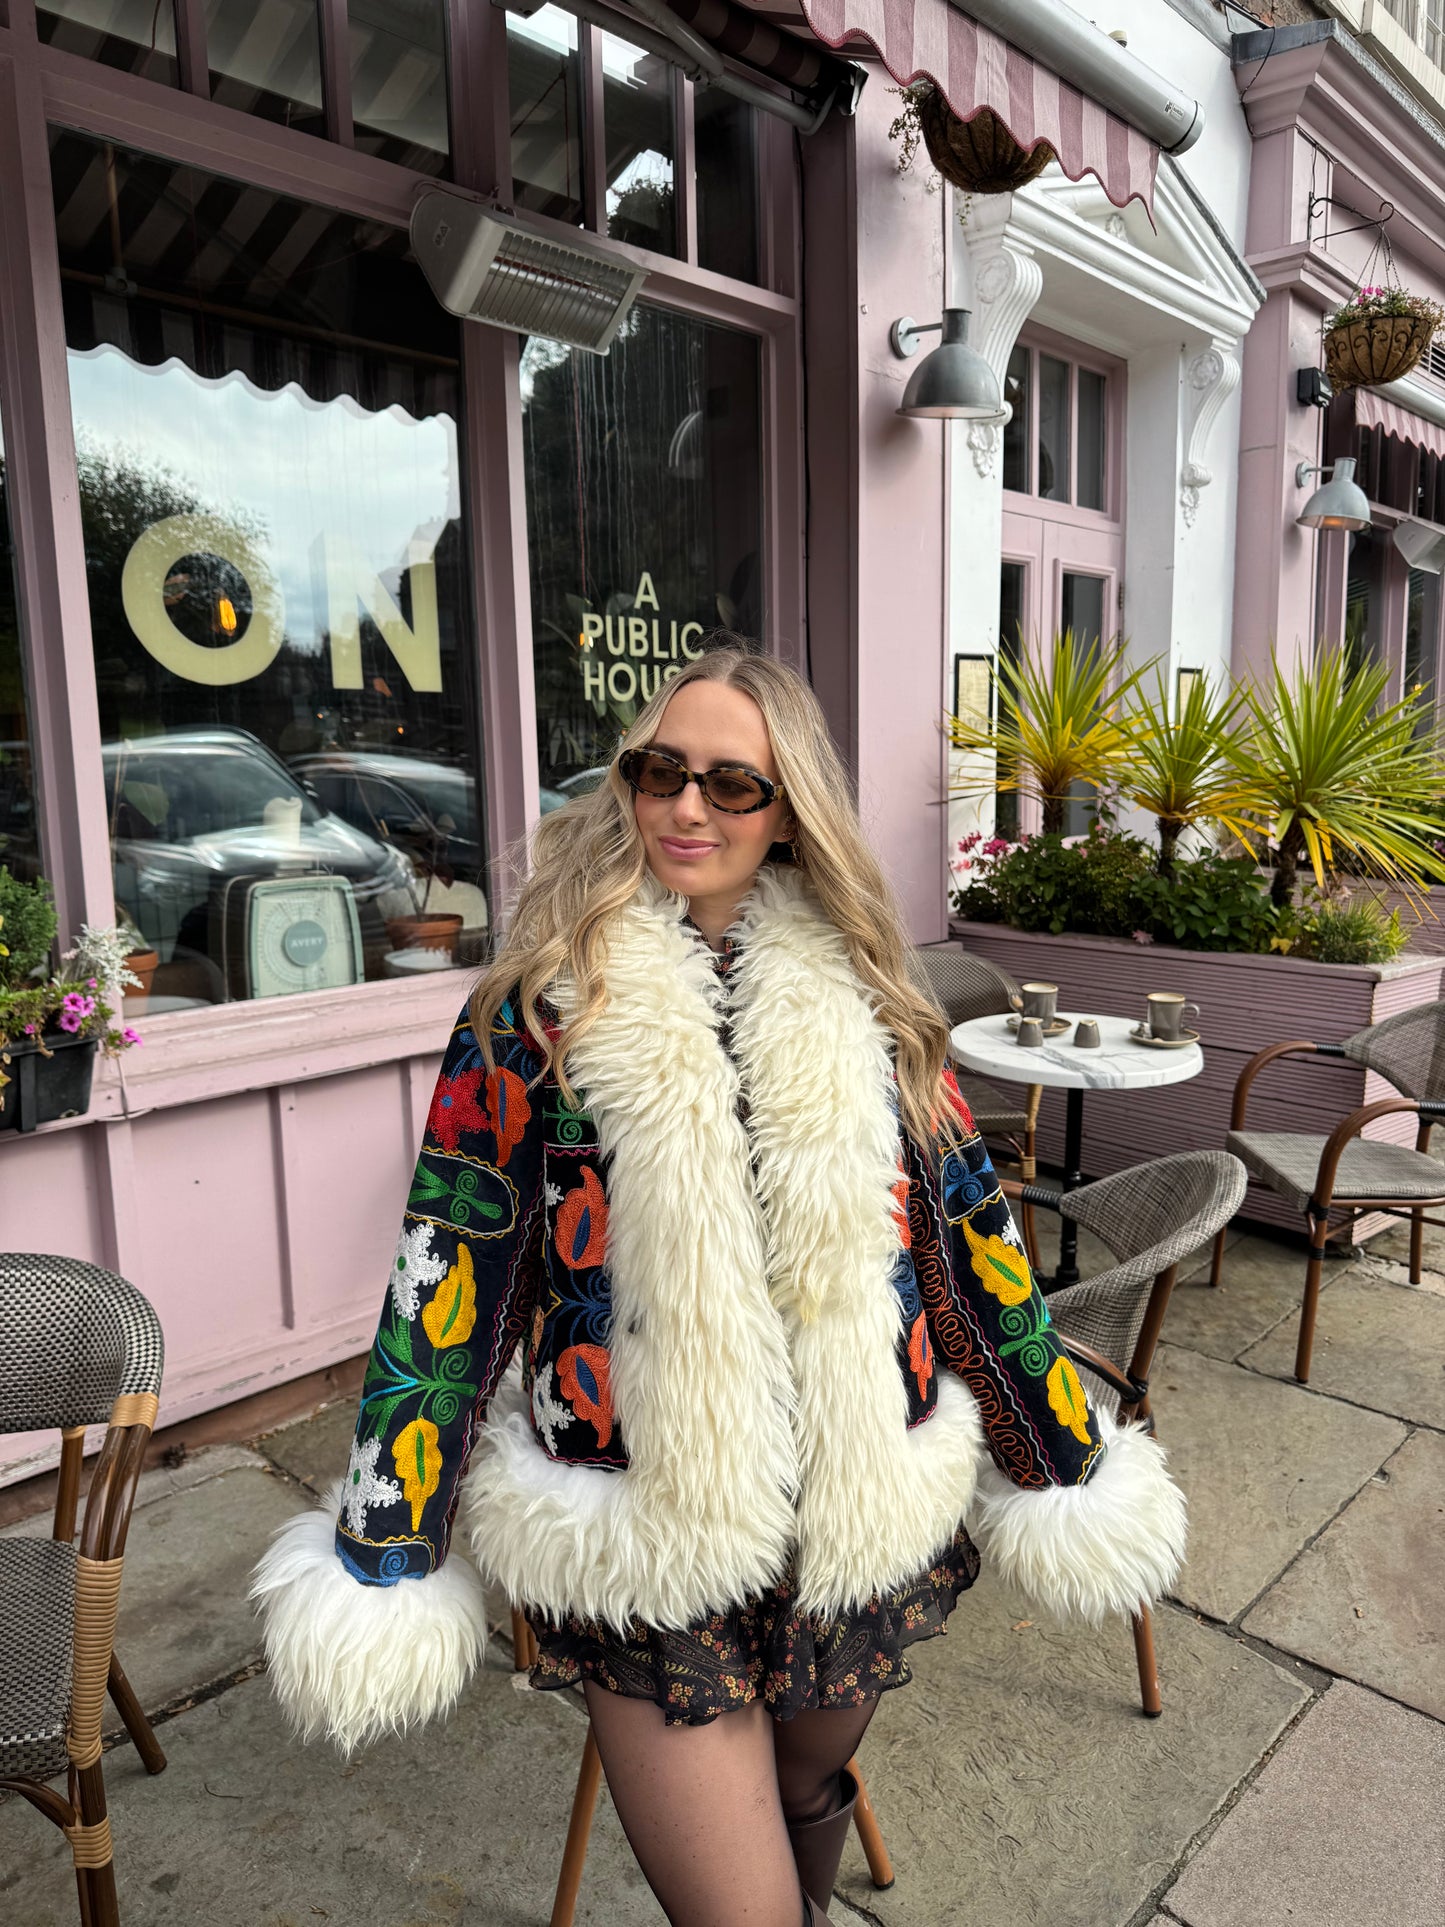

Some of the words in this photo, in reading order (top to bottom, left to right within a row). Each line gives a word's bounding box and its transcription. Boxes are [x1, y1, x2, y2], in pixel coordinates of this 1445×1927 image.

[121, 514, 443, 693] ON
[633, 571, 660, 611] A
[582, 613, 704, 660] PUBLIC
[583, 661, 681, 703] HOU
